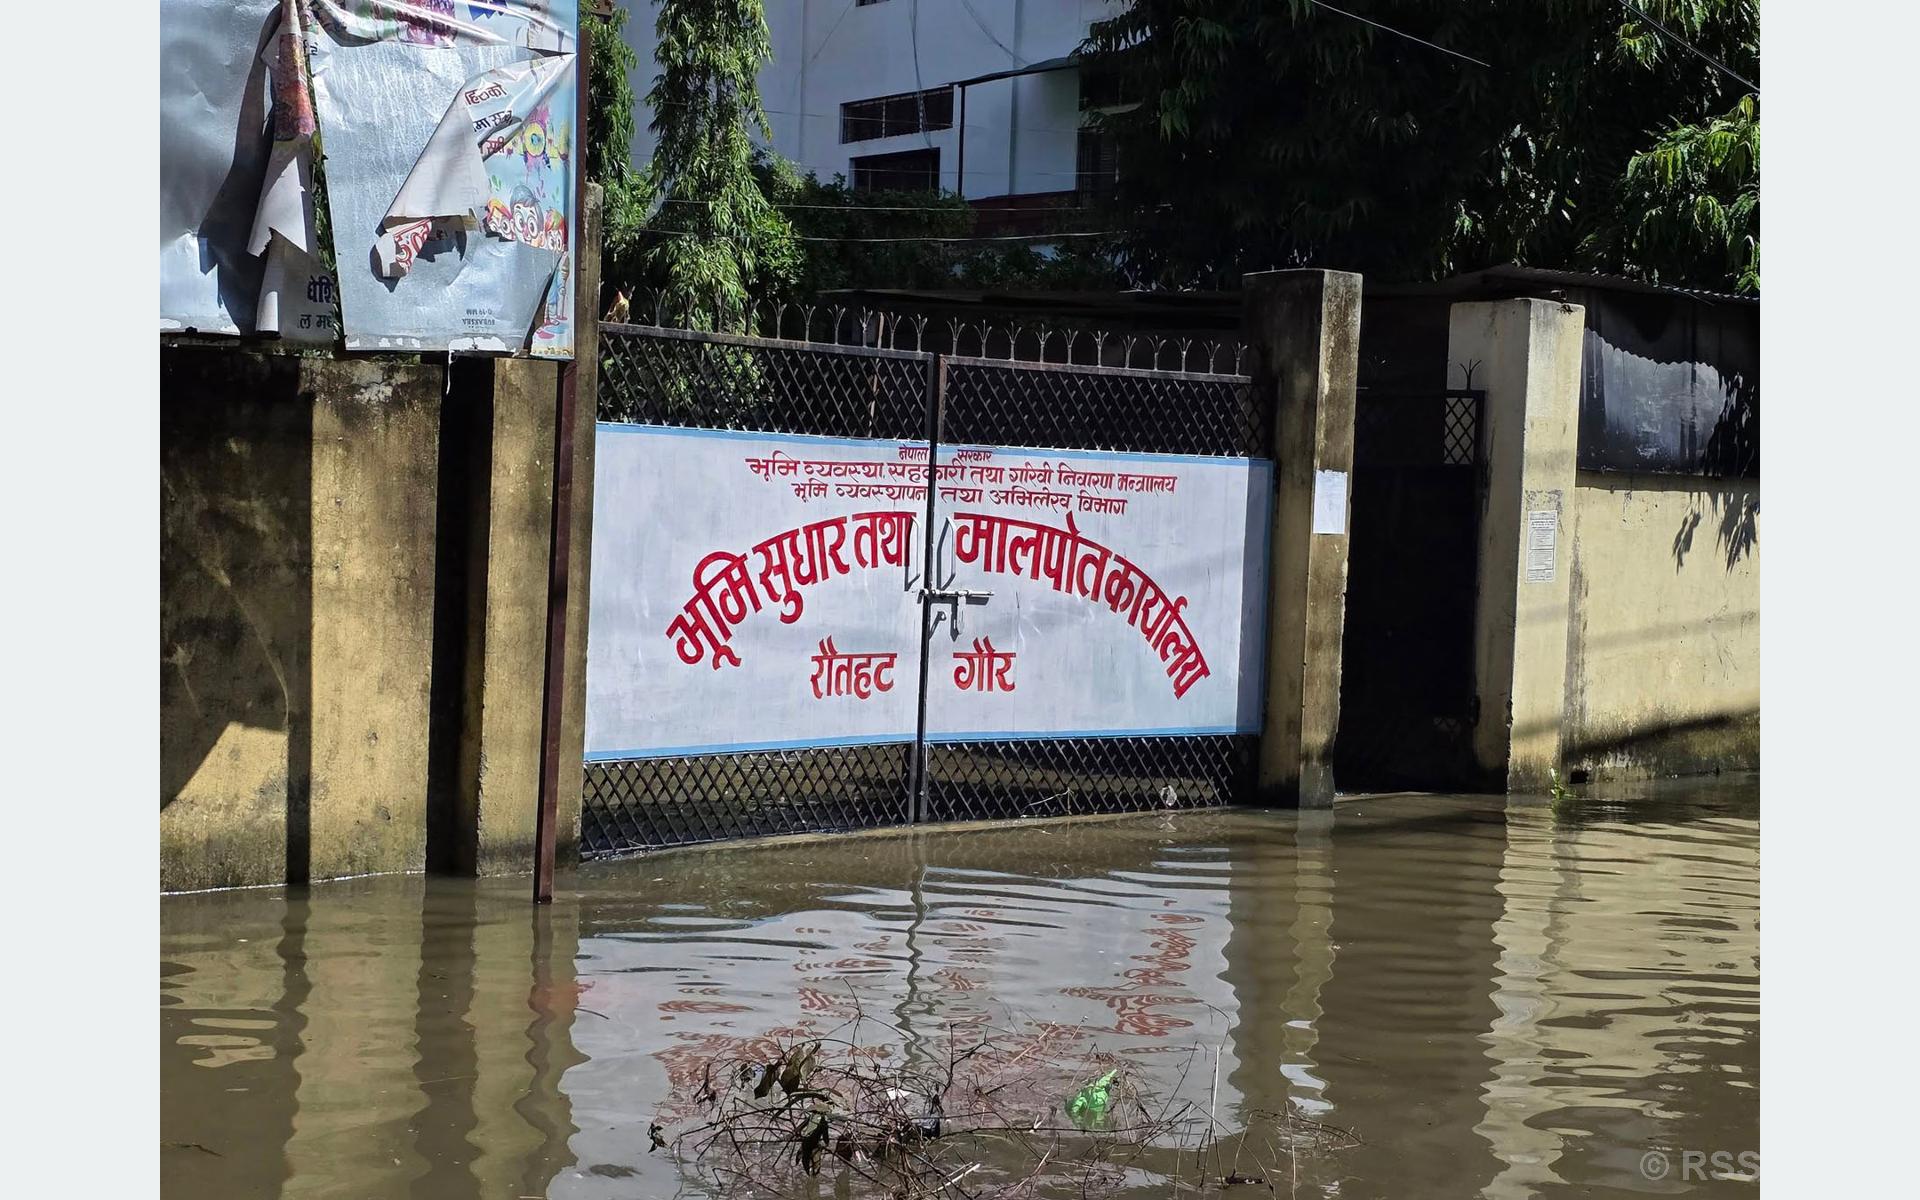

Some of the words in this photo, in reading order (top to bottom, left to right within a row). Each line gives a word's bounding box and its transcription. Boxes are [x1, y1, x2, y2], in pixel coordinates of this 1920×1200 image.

[745, 450, 800, 482] भूमि
[887, 458, 967, 485] सहकारी
[970, 466, 1005, 486] तथा
[1057, 462, 1115, 494] निवारण
[898, 444, 929, 461] नेपाल
[957, 449, 992, 463] सरकार
[791, 478, 828, 503] भूमि
[835, 484, 928, 503] व्यवस्थापन
[938, 486, 983, 503] तथा
[988, 486, 1073, 513] अभिलेख
[1077, 489, 1128, 515] विभाग
[665, 550, 763, 671] भूमि
[752, 516, 850, 624] सुधार
[852, 511, 917, 569] तथा
[954, 511, 1113, 603] मालपोत
[1104, 550, 1211, 700] कार्यालय
[809, 635, 898, 700] रौतहट
[953, 636, 1016, 692] गौर
